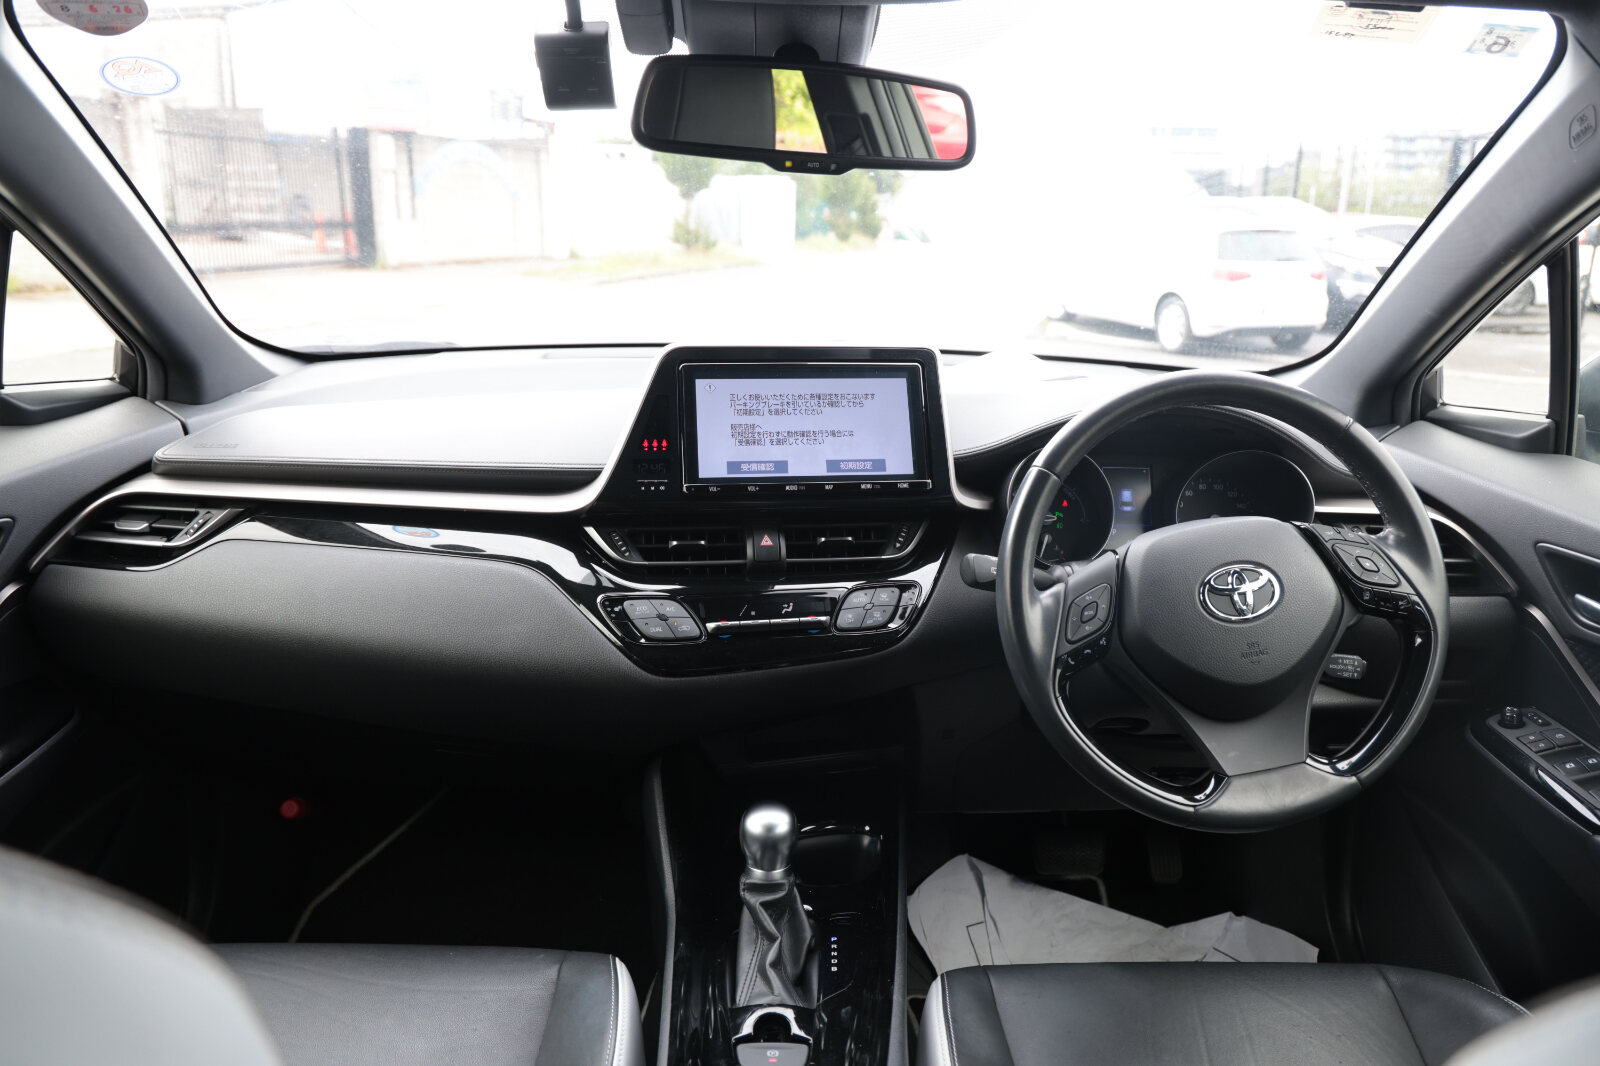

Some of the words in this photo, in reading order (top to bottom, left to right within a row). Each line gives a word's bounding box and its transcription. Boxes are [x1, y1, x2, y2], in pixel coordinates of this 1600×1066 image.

[740, 463, 775, 472] 受信確認
[839, 461, 873, 470] 初期設定
[1241, 649, 1269, 660] AIRBAG
